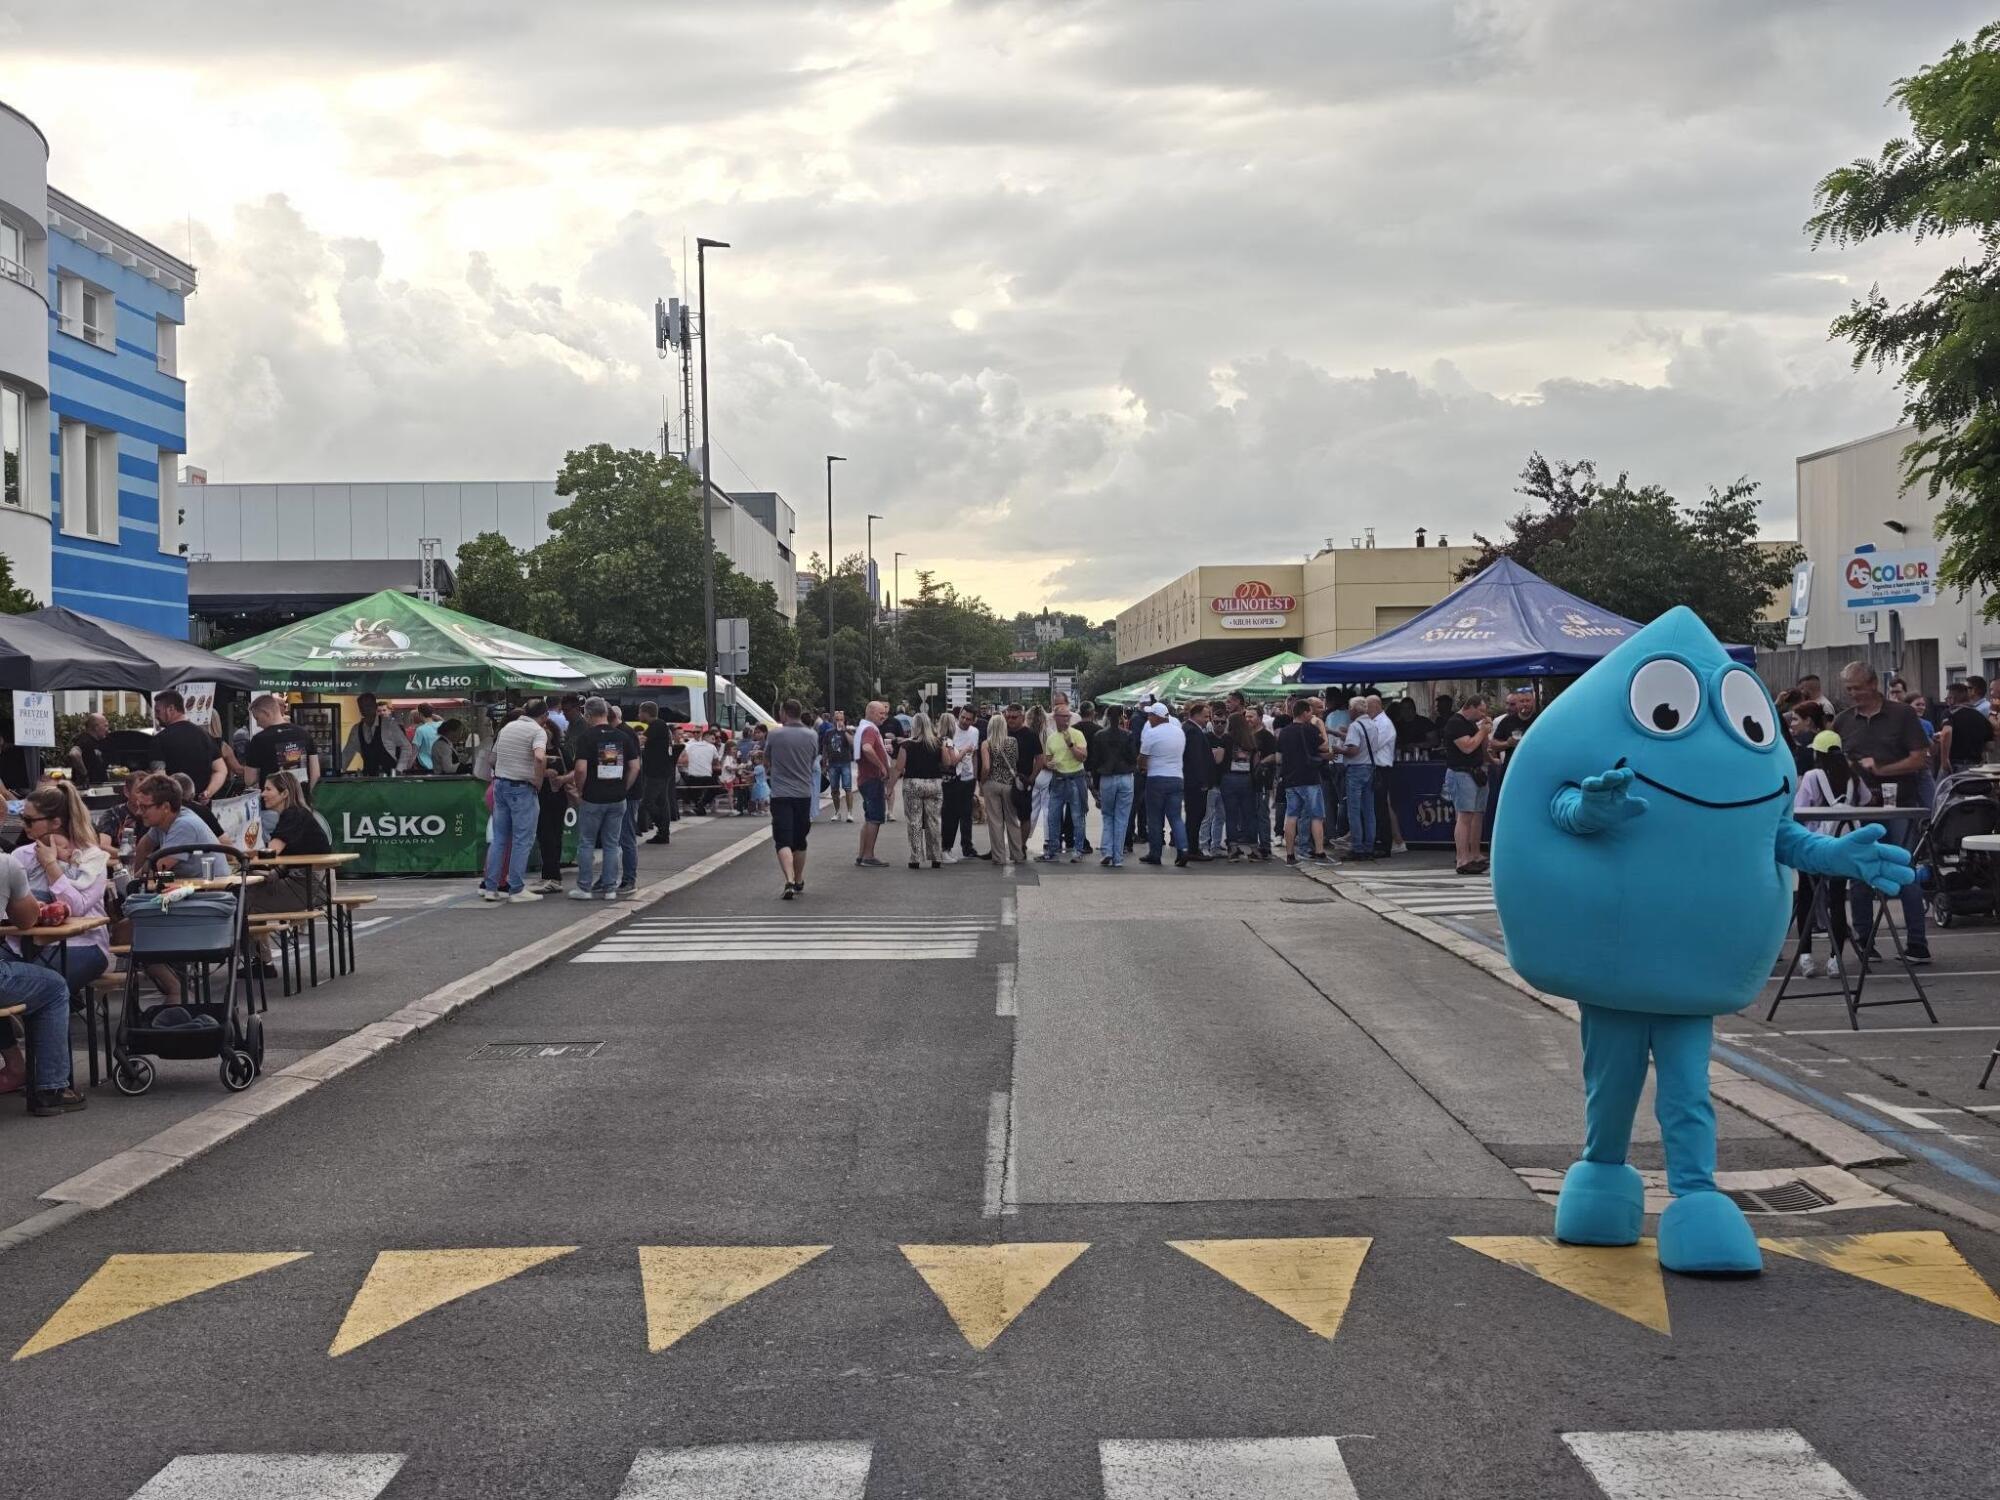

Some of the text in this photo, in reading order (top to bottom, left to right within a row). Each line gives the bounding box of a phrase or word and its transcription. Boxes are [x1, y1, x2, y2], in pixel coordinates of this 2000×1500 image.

[1871, 562, 1928, 582] COLOR
[1795, 571, 1808, 609] P
[1218, 598, 1290, 610] MLINOTEST
[1420, 627, 1496, 642] Hirter
[301, 680, 353, 688] SLOVENSKO
[425, 675, 471, 690] LAŠKO
[342, 812, 446, 844] LAŠKO
[455, 813, 464, 837] 1825
